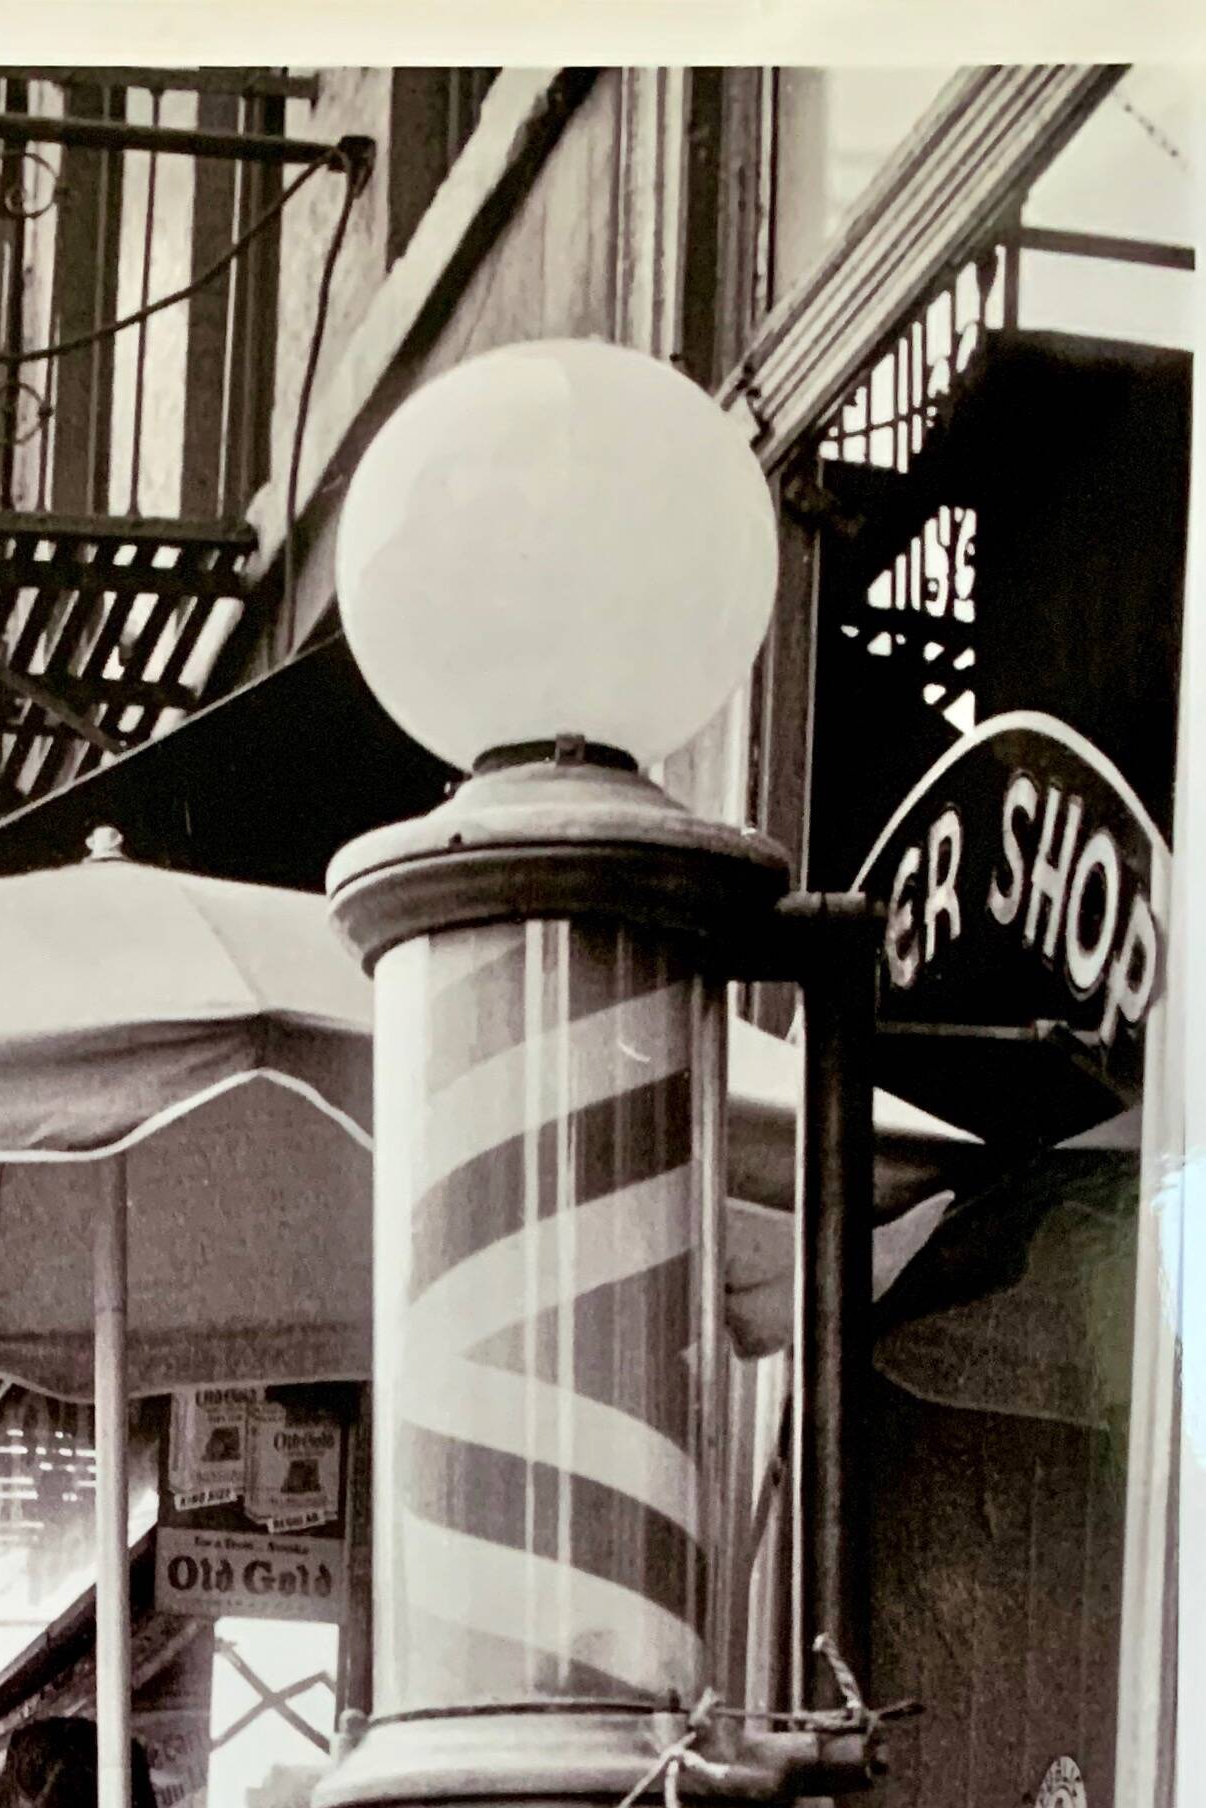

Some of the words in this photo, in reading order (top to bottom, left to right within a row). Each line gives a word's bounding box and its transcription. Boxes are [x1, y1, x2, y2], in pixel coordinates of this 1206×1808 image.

[988, 769, 1158, 1048] SHOP
[168, 1555, 234, 1593] Old
[243, 1560, 332, 1599] Gold
